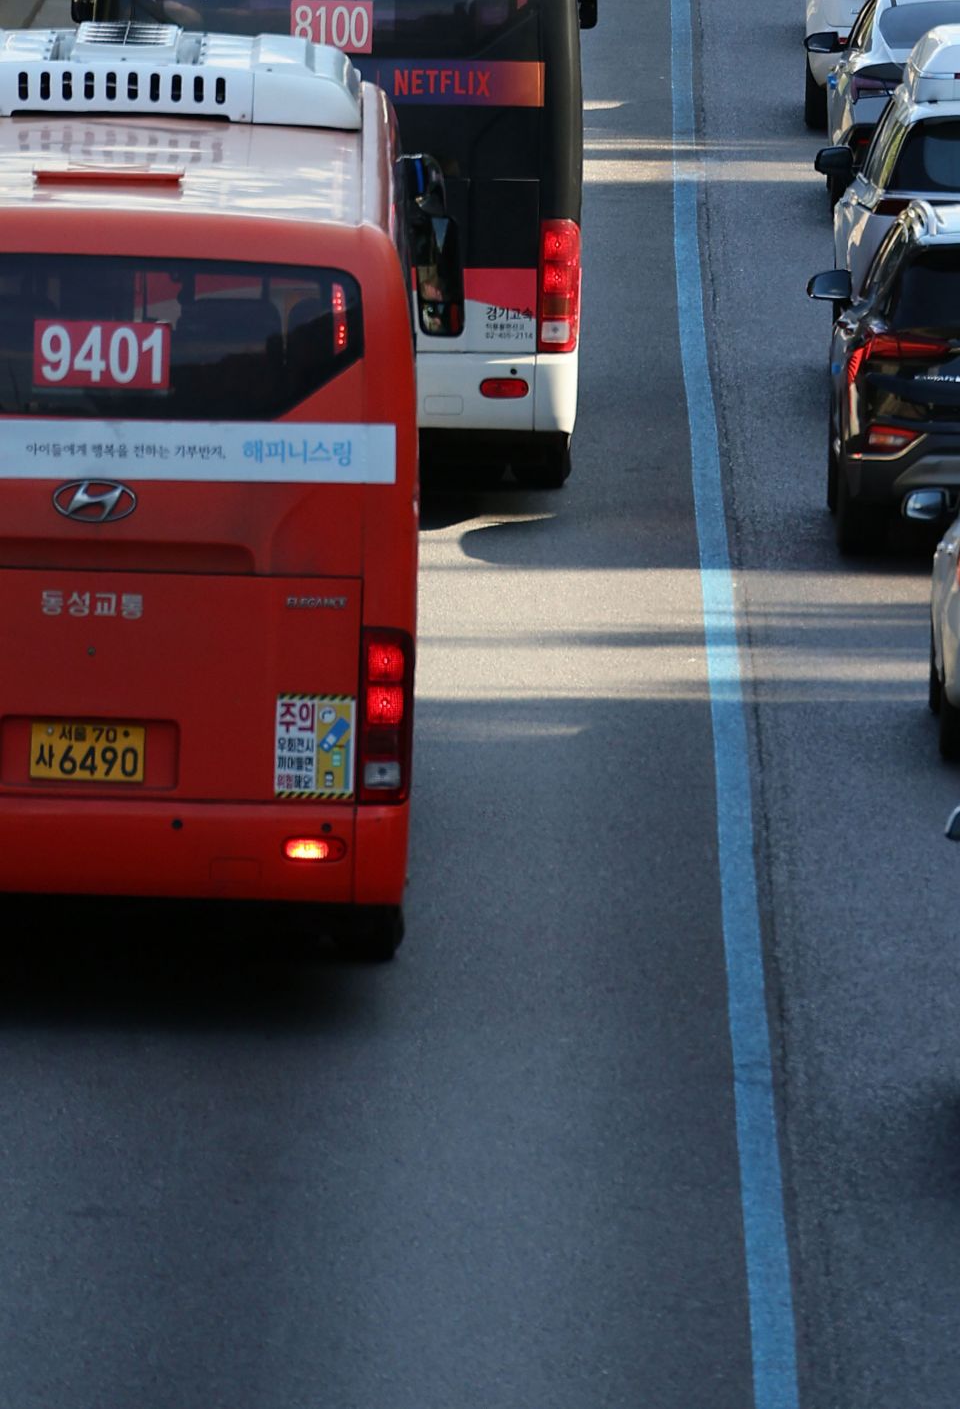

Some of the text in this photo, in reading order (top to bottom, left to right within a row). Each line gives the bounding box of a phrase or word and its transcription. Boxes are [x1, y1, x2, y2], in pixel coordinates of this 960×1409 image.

[294, 5, 369, 48] 8100
[394, 69, 492, 97] NETFLIX
[486, 306, 533, 322] 경기고속
[40, 324, 164, 384] 9401
[26, 442, 88, 458] 아이들에게
[91, 443, 129, 459] 행복을
[133, 444, 170, 460] 전하는
[242, 439, 353, 467] 해피니스링
[41, 589, 144, 620] 동성교통
[278, 702, 316, 734] 주의
[59, 726, 118, 744] 서울 70
[277, 756, 315, 772] 끼어들면
